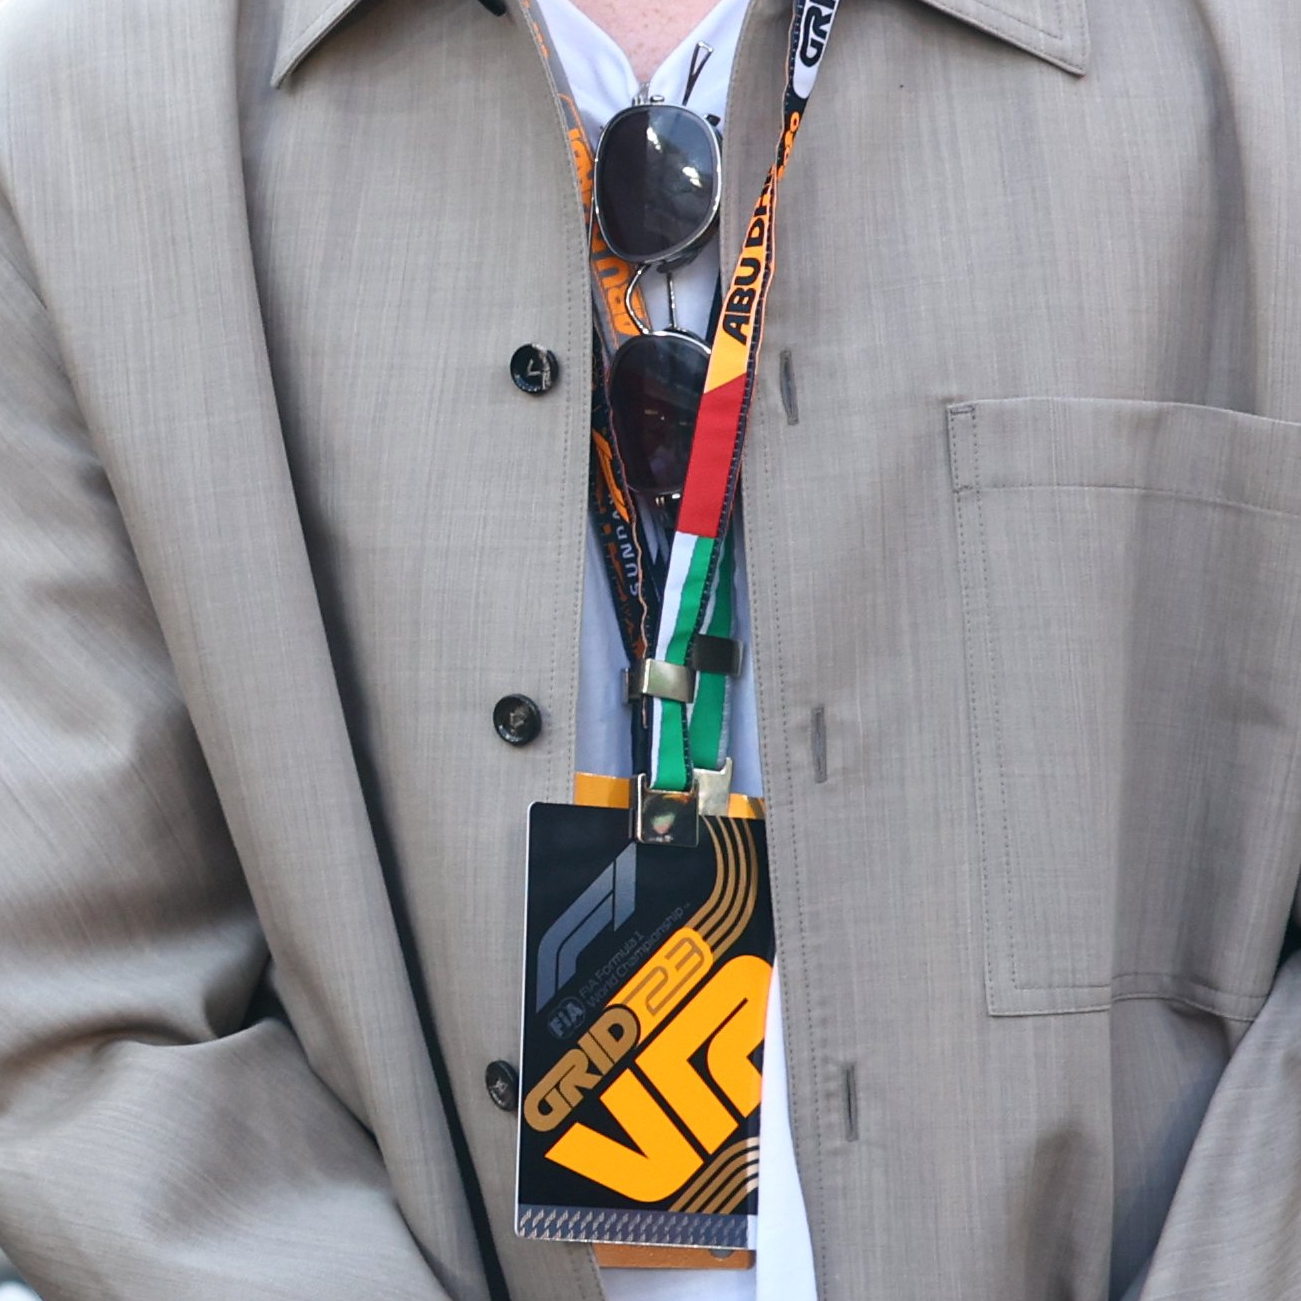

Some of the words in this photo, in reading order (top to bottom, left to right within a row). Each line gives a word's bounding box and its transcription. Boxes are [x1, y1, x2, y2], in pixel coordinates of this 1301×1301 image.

[722, 255, 762, 344] ABU
[586, 973, 621, 1009] World
[595, 939, 639, 981] Formula
[524, 1005, 639, 1131] GRID
[544, 955, 773, 1203] VIP
